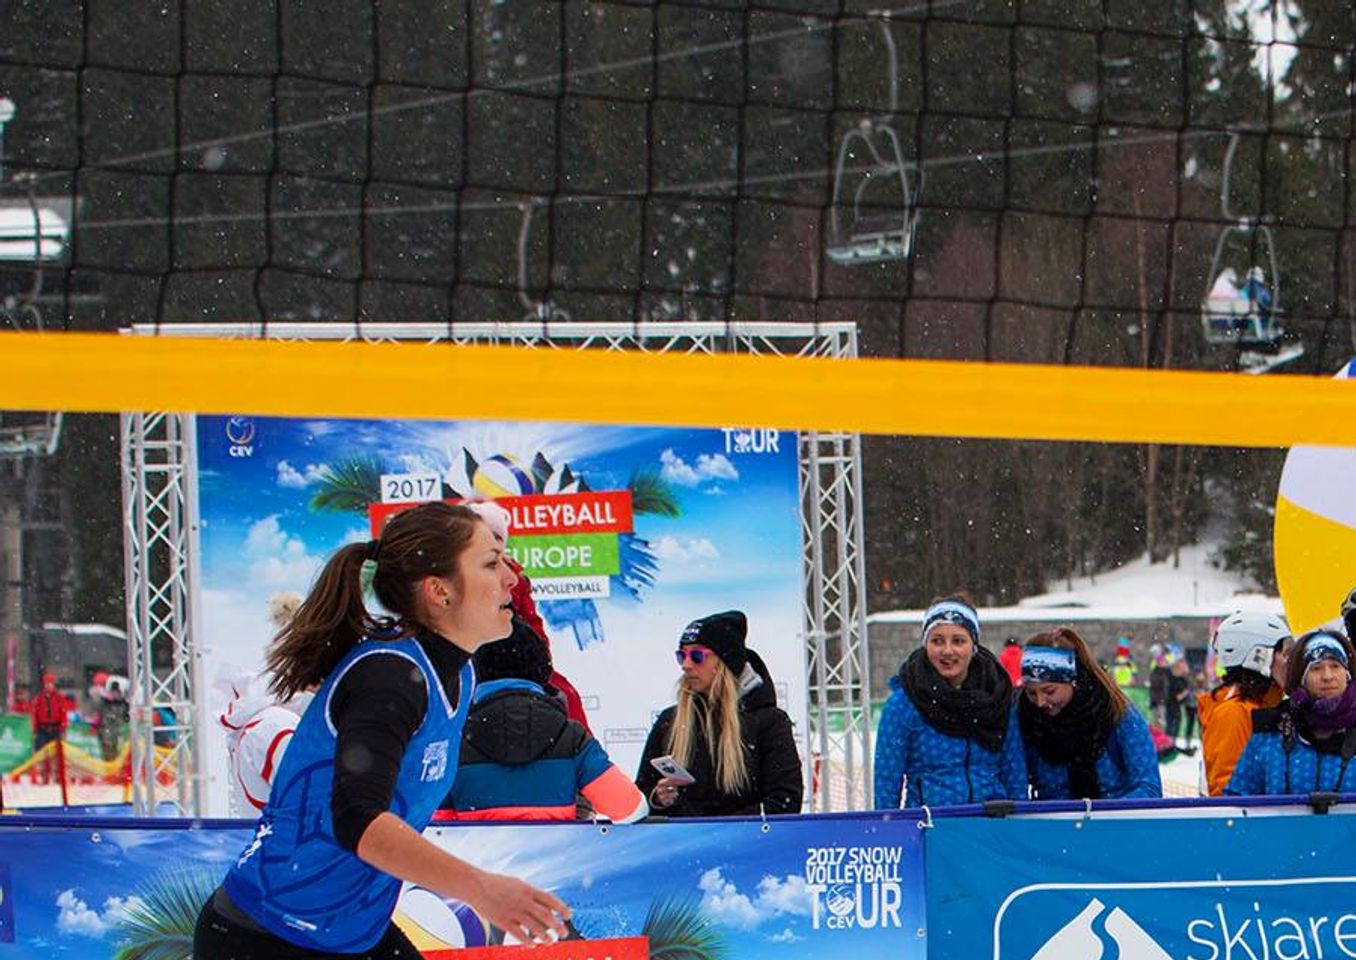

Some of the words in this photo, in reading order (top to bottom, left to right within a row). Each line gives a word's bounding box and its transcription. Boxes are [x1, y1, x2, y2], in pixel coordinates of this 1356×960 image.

[229, 445, 254, 457] CEV
[387, 479, 436, 499] 2017
[806, 848, 846, 865] 2017
[848, 846, 902, 864] SNOW
[806, 863, 903, 884] VOLLEYBALL
[806, 882, 902, 930] TOUR
[826, 915, 856, 930] CEV
